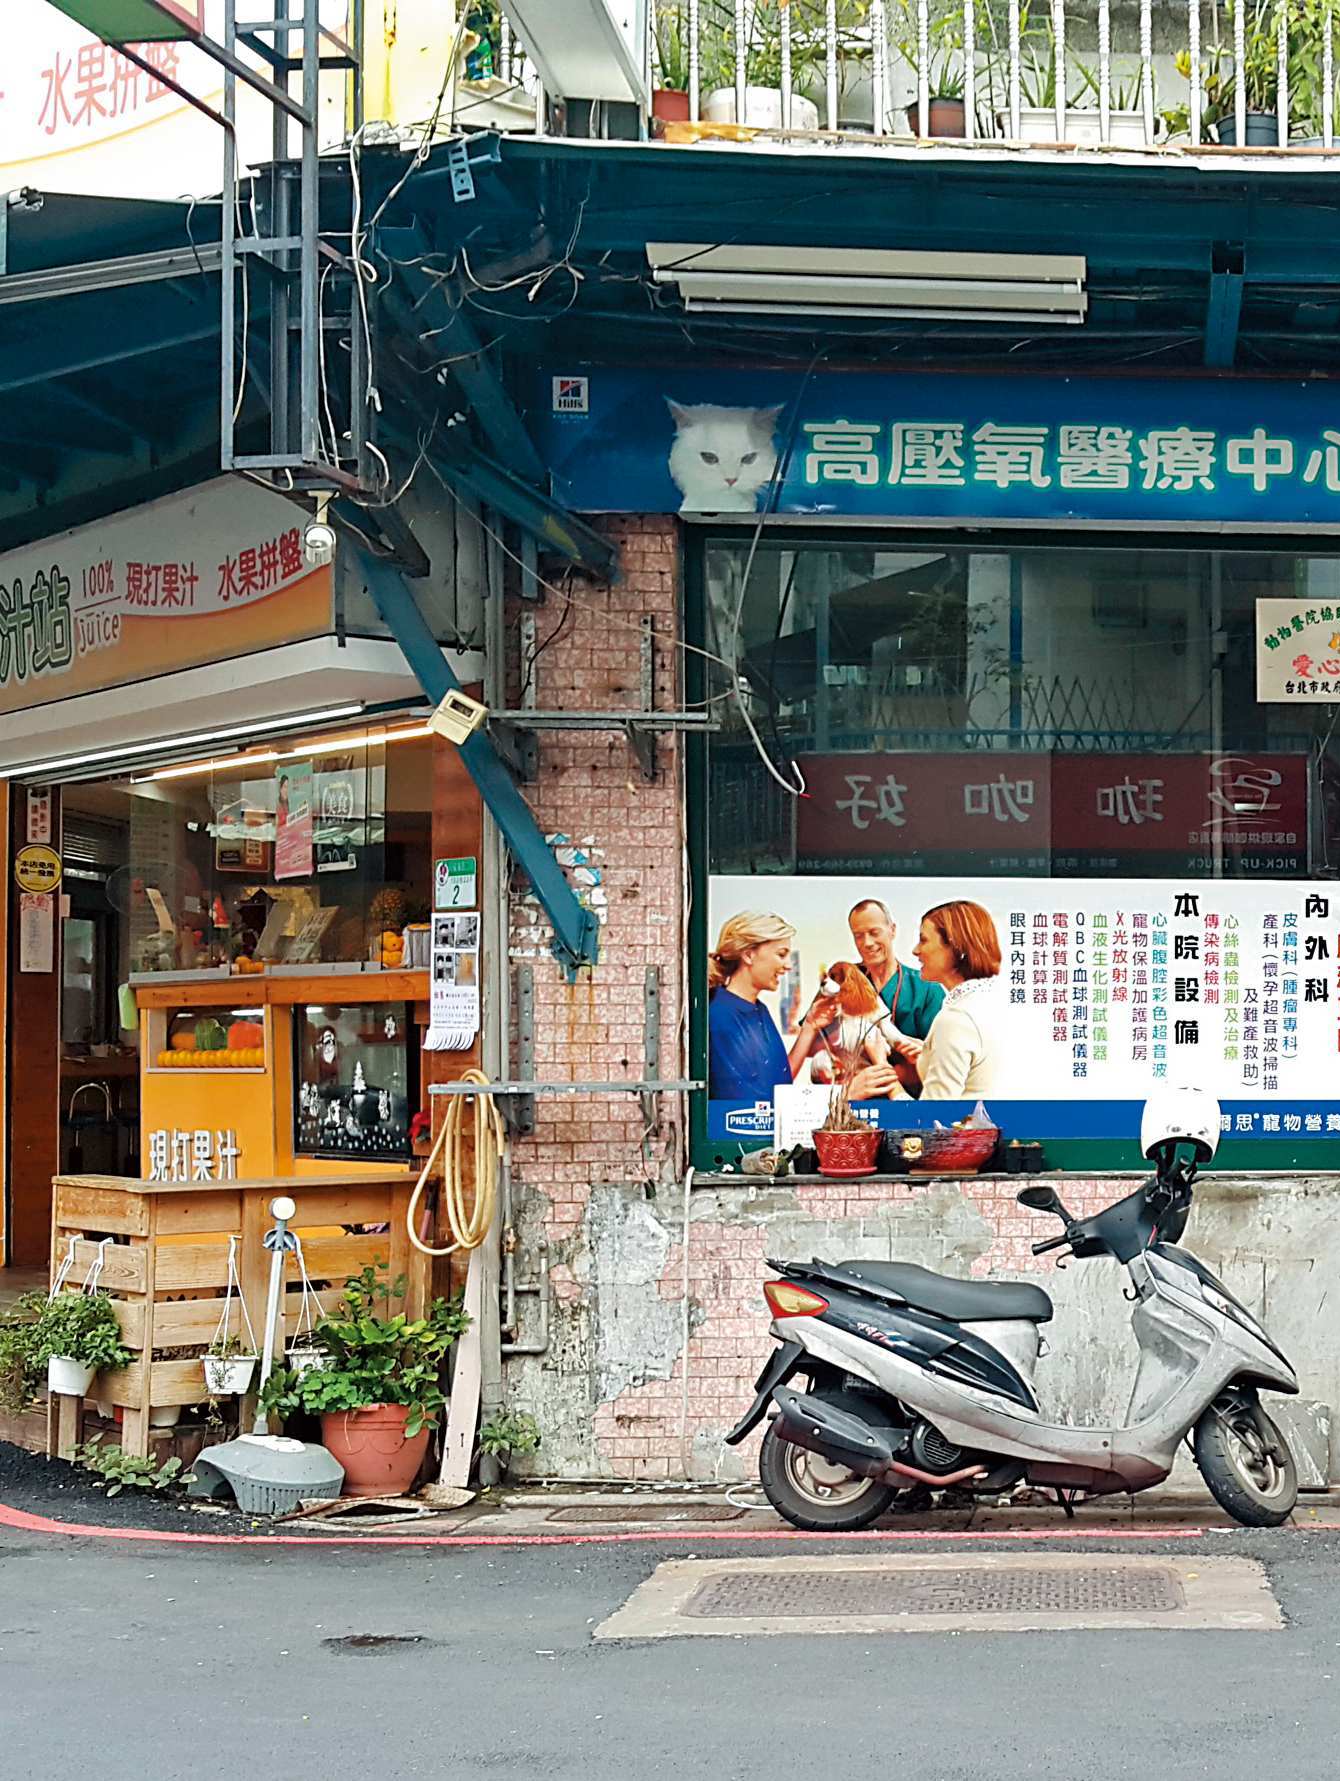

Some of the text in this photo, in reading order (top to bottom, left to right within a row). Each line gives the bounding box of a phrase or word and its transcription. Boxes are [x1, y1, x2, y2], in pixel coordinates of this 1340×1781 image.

[83, 559, 114, 599] 100%
[126, 561, 199, 608] 現打果汁
[218, 527, 304, 601] 水果拼盤
[452, 885, 460, 905] 2
[1010, 912, 1026, 1004] 眼耳內視鏡
[1032, 913, 1048, 1004] 血球計算器
[1052, 912, 1068, 1042] 電解質測試儀器
[1092, 912, 1109, 1061] 血液生化測試儀器
[1112, 911, 1128, 1002] X光放射線
[1132, 912, 1148, 1061] 寵物保溫加護病房
[1174, 893, 1200, 1045] 本院設備
[1204, 913, 1220, 1005] 傳染病檢測
[1224, 914, 1240, 1061] 心絲蟲檢測及治療
[1304, 893, 1330, 1003] 內外科
[1072, 911, 1088, 1078] QBC血球測試儀器
[1152, 912, 1168, 1078] 心臟腹腔彩色超音波
[148, 1128, 242, 1181] 現打果汁
